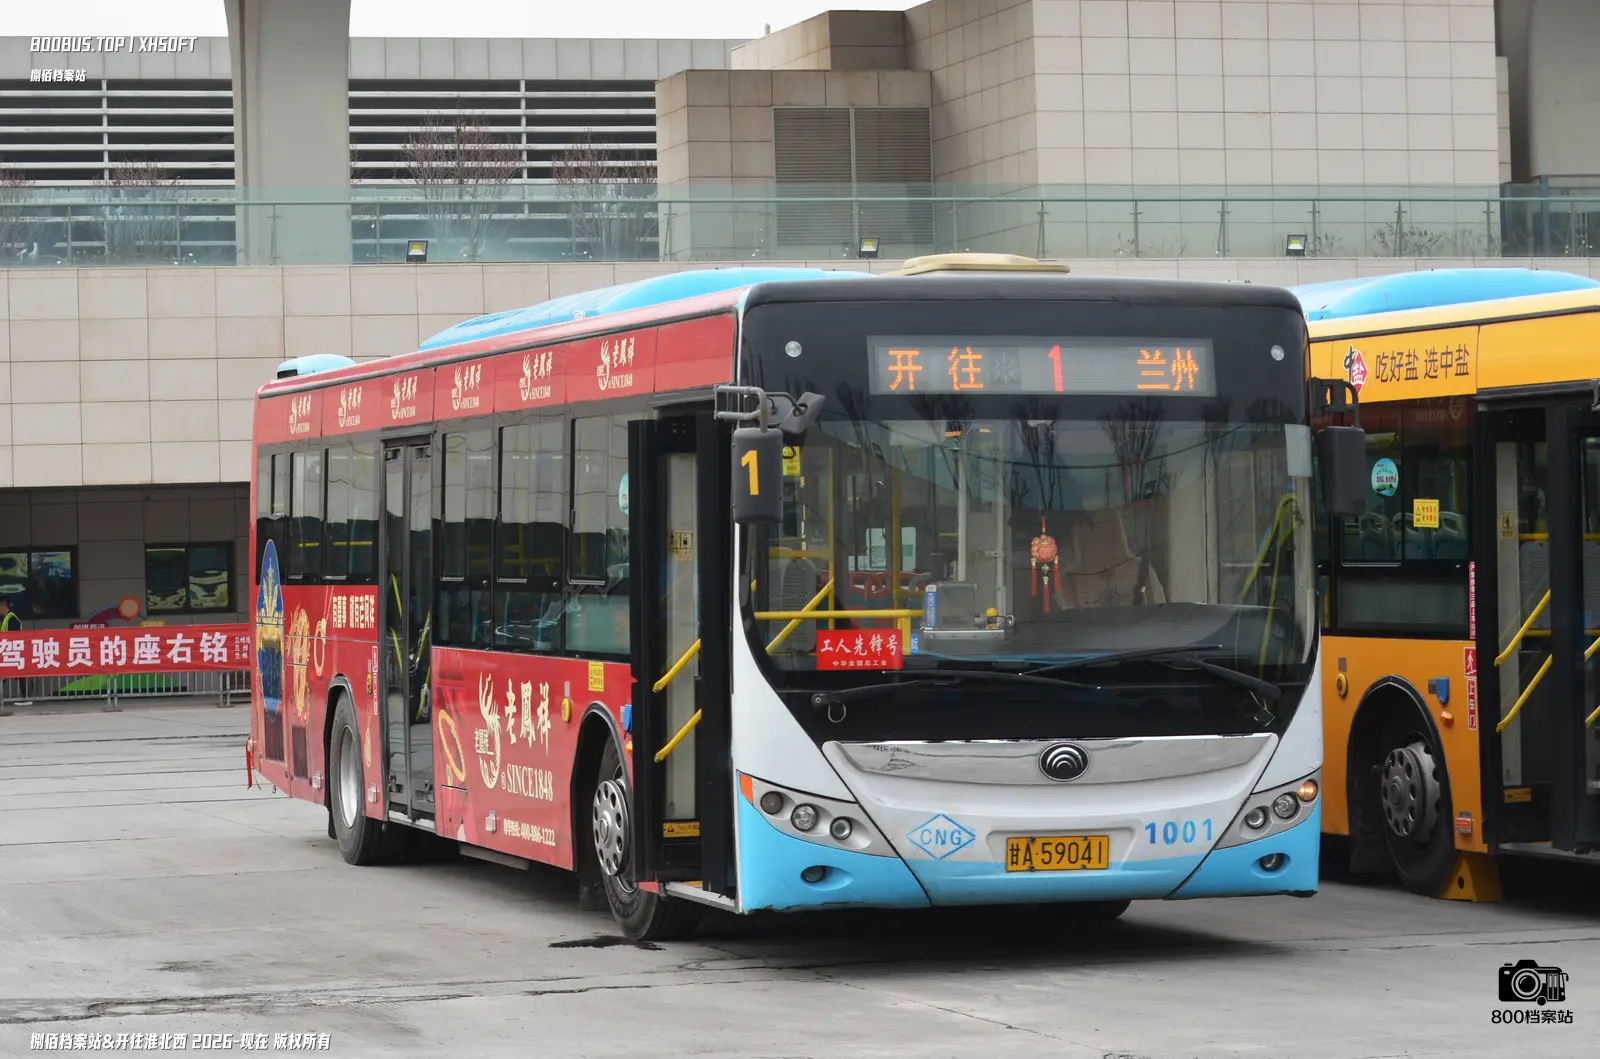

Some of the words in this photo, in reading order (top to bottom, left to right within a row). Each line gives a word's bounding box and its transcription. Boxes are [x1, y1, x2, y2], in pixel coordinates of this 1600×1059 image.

[1047, 345, 1063, 392] 1
[1137, 348, 1199, 391] 兰州
[1375, 350, 1419, 383] 吃好盐
[1423, 343, 1470, 380] 选中盐
[741, 450, 759, 496] 1
[0, 631, 228, 670] 驾驶员的座右铭
[820, 633, 898, 656] 工人先锋号
[506, 763, 554, 802] SINCE1848
[919, 828, 962, 847] CNG
[1145, 818, 1213, 845] 1001
